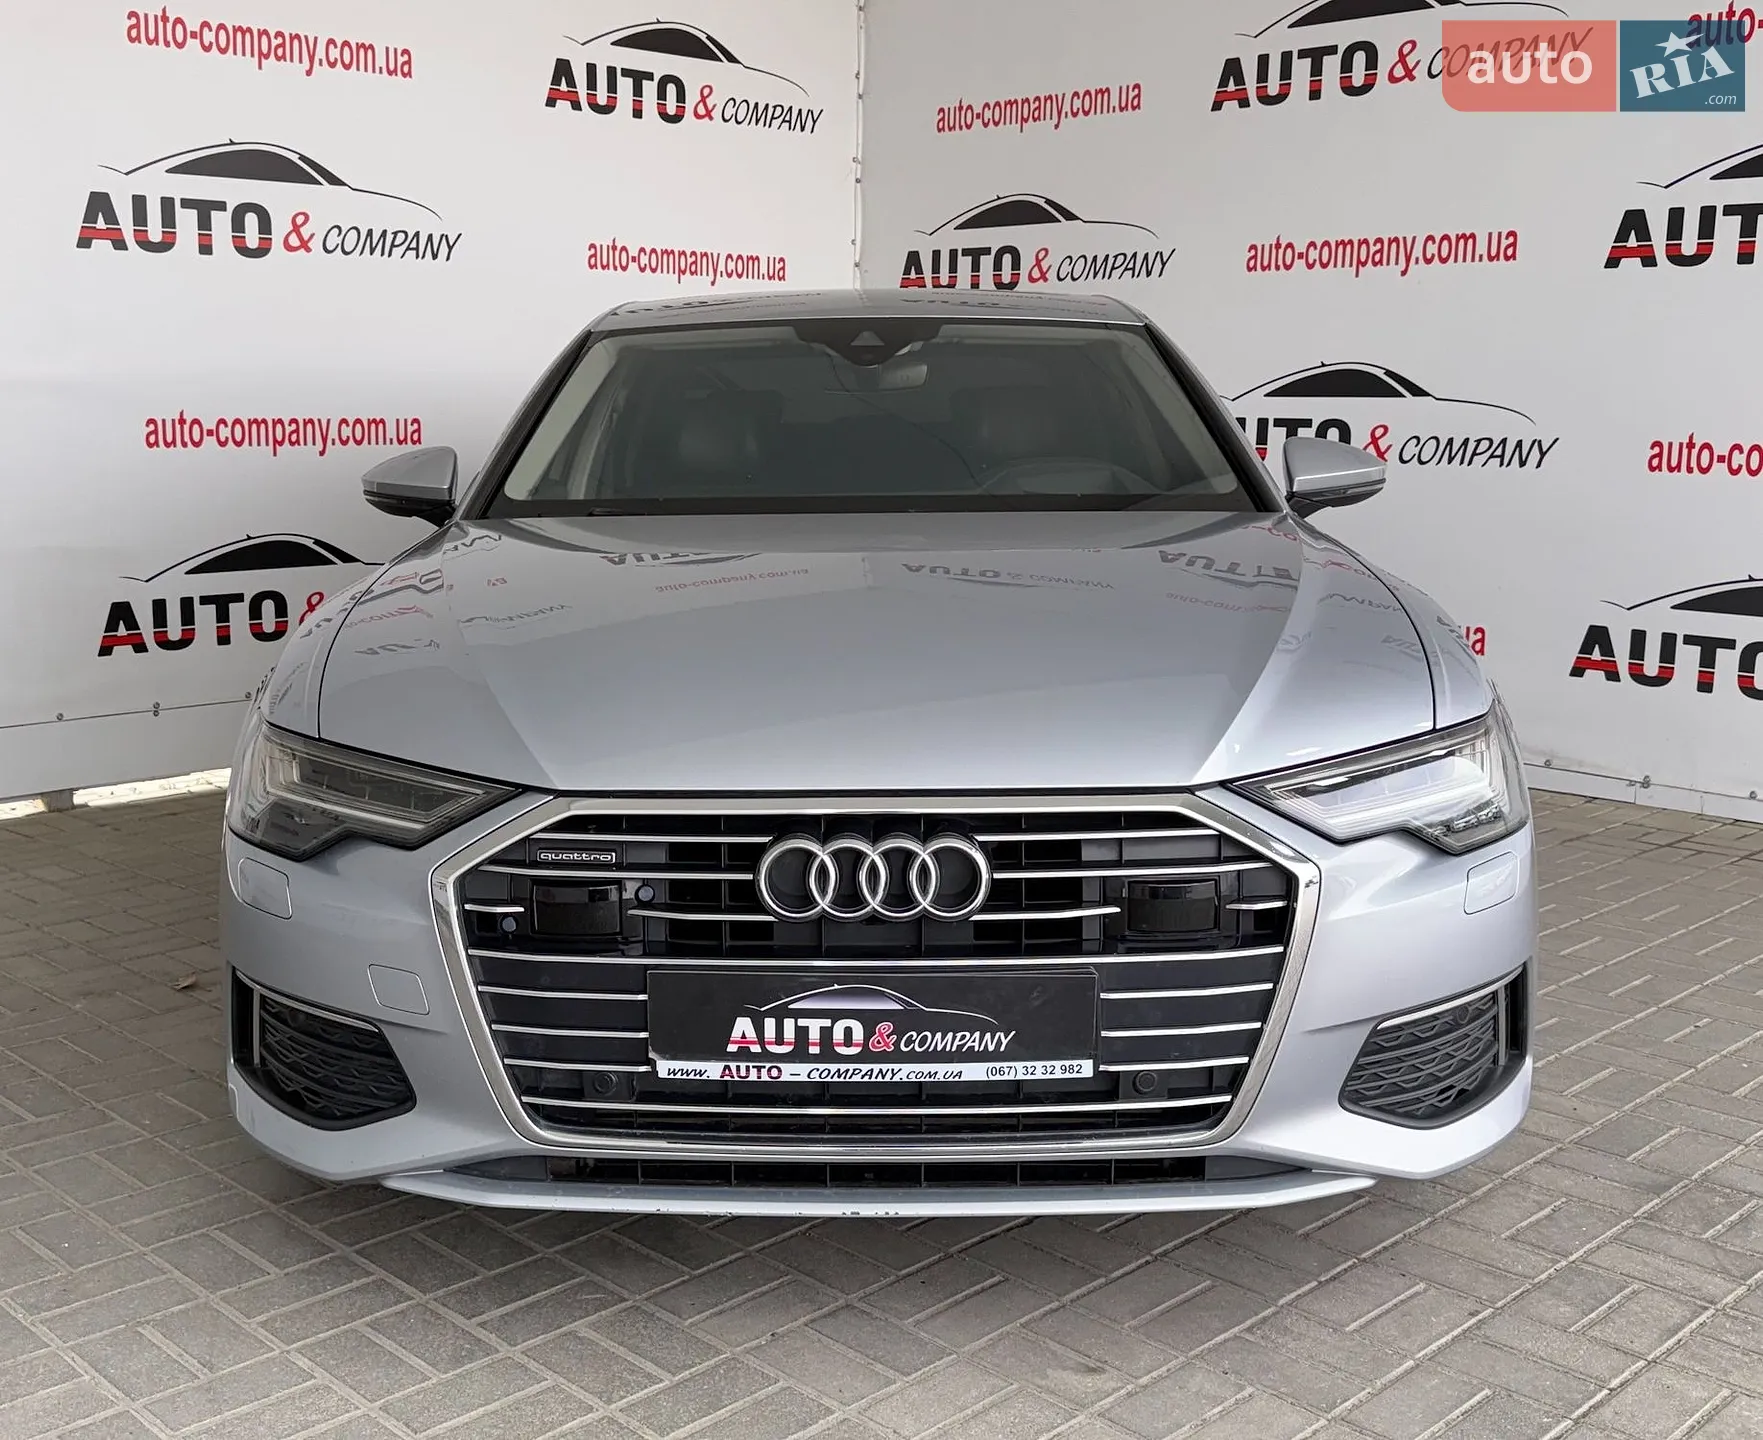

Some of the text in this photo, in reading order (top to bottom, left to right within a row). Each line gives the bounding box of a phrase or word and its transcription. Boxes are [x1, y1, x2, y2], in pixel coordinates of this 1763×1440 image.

[126, 6, 413, 79] auto-company.com.ua
[545, 57, 824, 134] AUTO & COMPANY
[1211, 40, 1379, 112] AUTO
[1386, 39, 1420, 85] &
[937, 82, 1142, 133] auto-company.com.ua
[77, 191, 462, 261] AUTO & COMPANY
[588, 237, 787, 286] auto-company.com.ua
[899, 245, 1176, 290] AUTO & COMPANY
[1246, 230, 1519, 277] auto-company.com.ua
[144, 410, 423, 457] auto-company.com.ua
[1398, 435, 1560, 469] COMPANY
[97, 589, 289, 657] AUTO
[540, 852, 611, 861] quattro
[726, 1017, 1016, 1055] AUTO & COMPANY
[719, 1065, 782, 1079] AUTO
[985, 1065, 1018, 1078] (067)
[1022, 1065, 1037, 1076] 32
[1041, 1064, 1056, 1076] 32
[1060, 1063, 1083, 1075] 982
